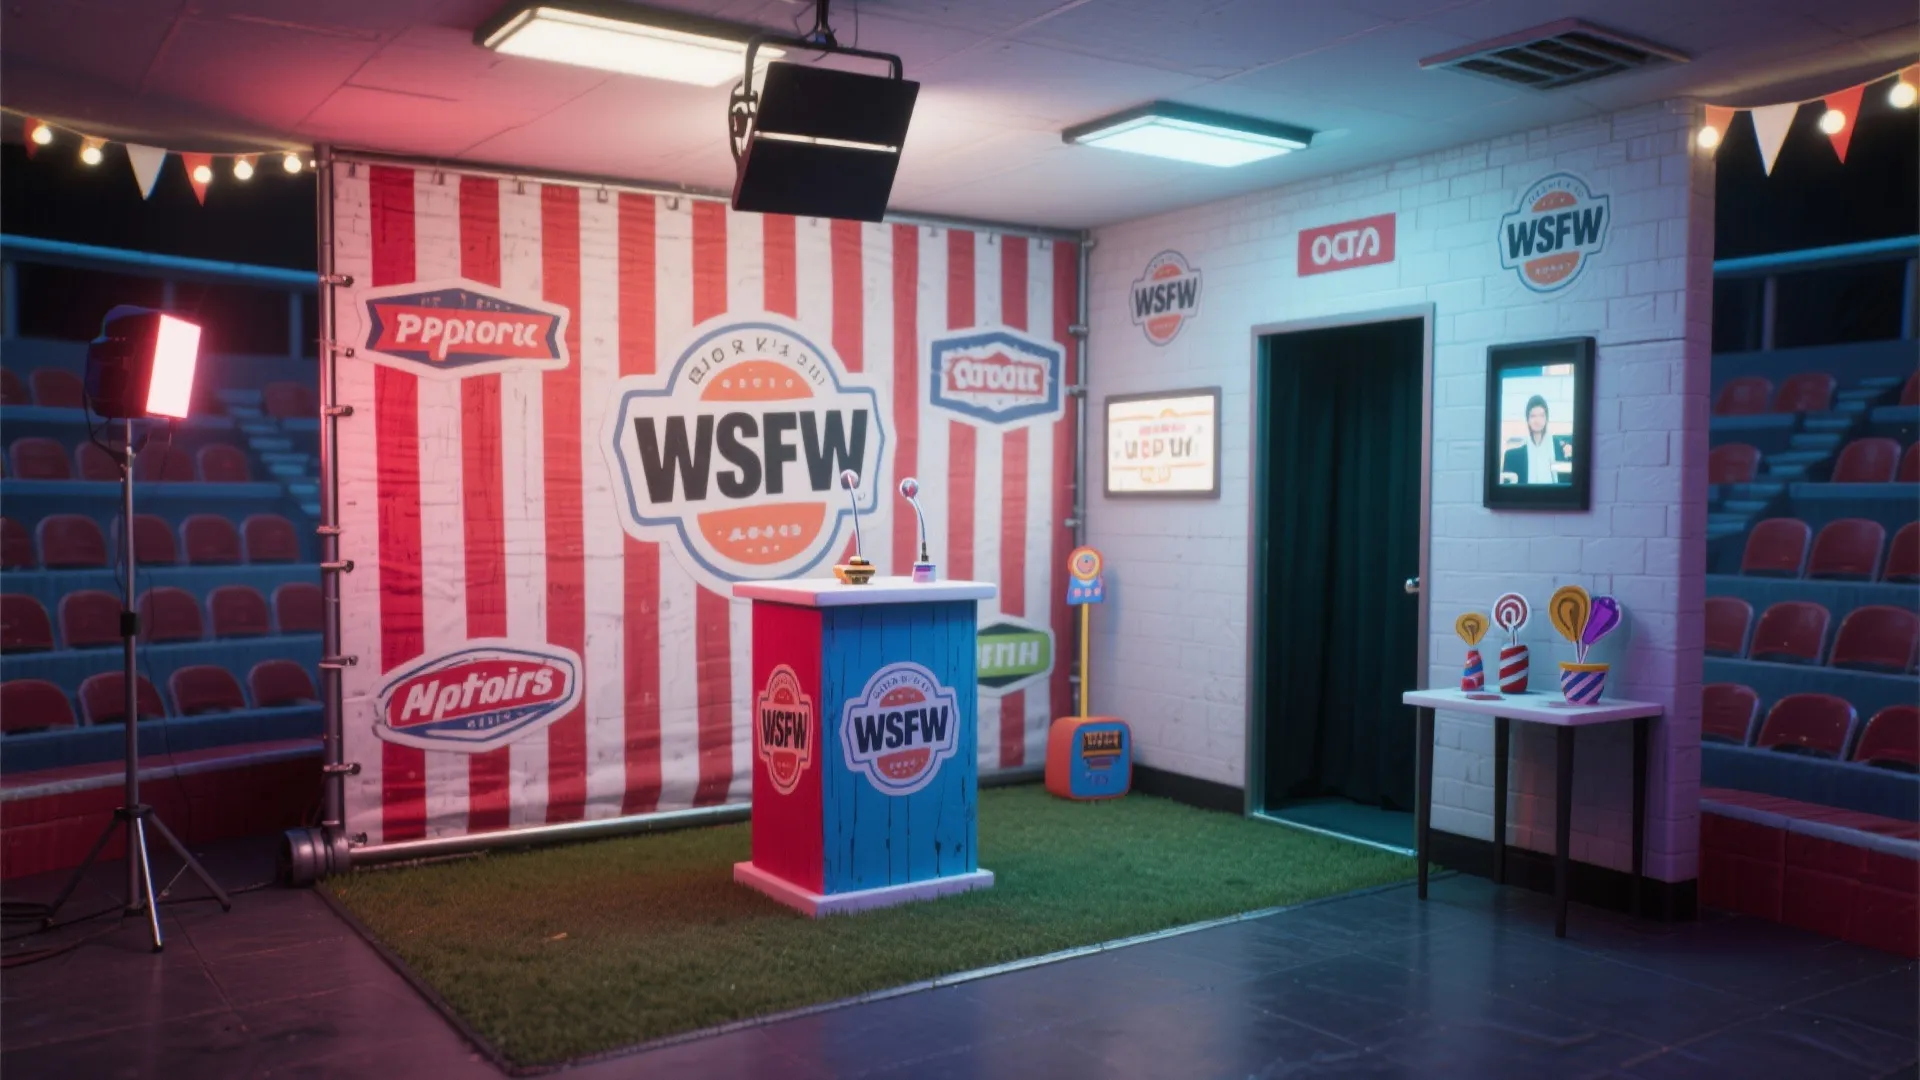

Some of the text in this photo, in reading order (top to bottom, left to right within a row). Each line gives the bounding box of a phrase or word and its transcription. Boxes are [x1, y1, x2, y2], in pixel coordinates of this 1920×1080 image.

[1507, 205, 1603, 259] WSFW
[1135, 277, 1197, 317] WSFW
[634, 409, 868, 503] WSFW
[762, 708, 807, 749] WSFW
[854, 705, 948, 754] WSFW
